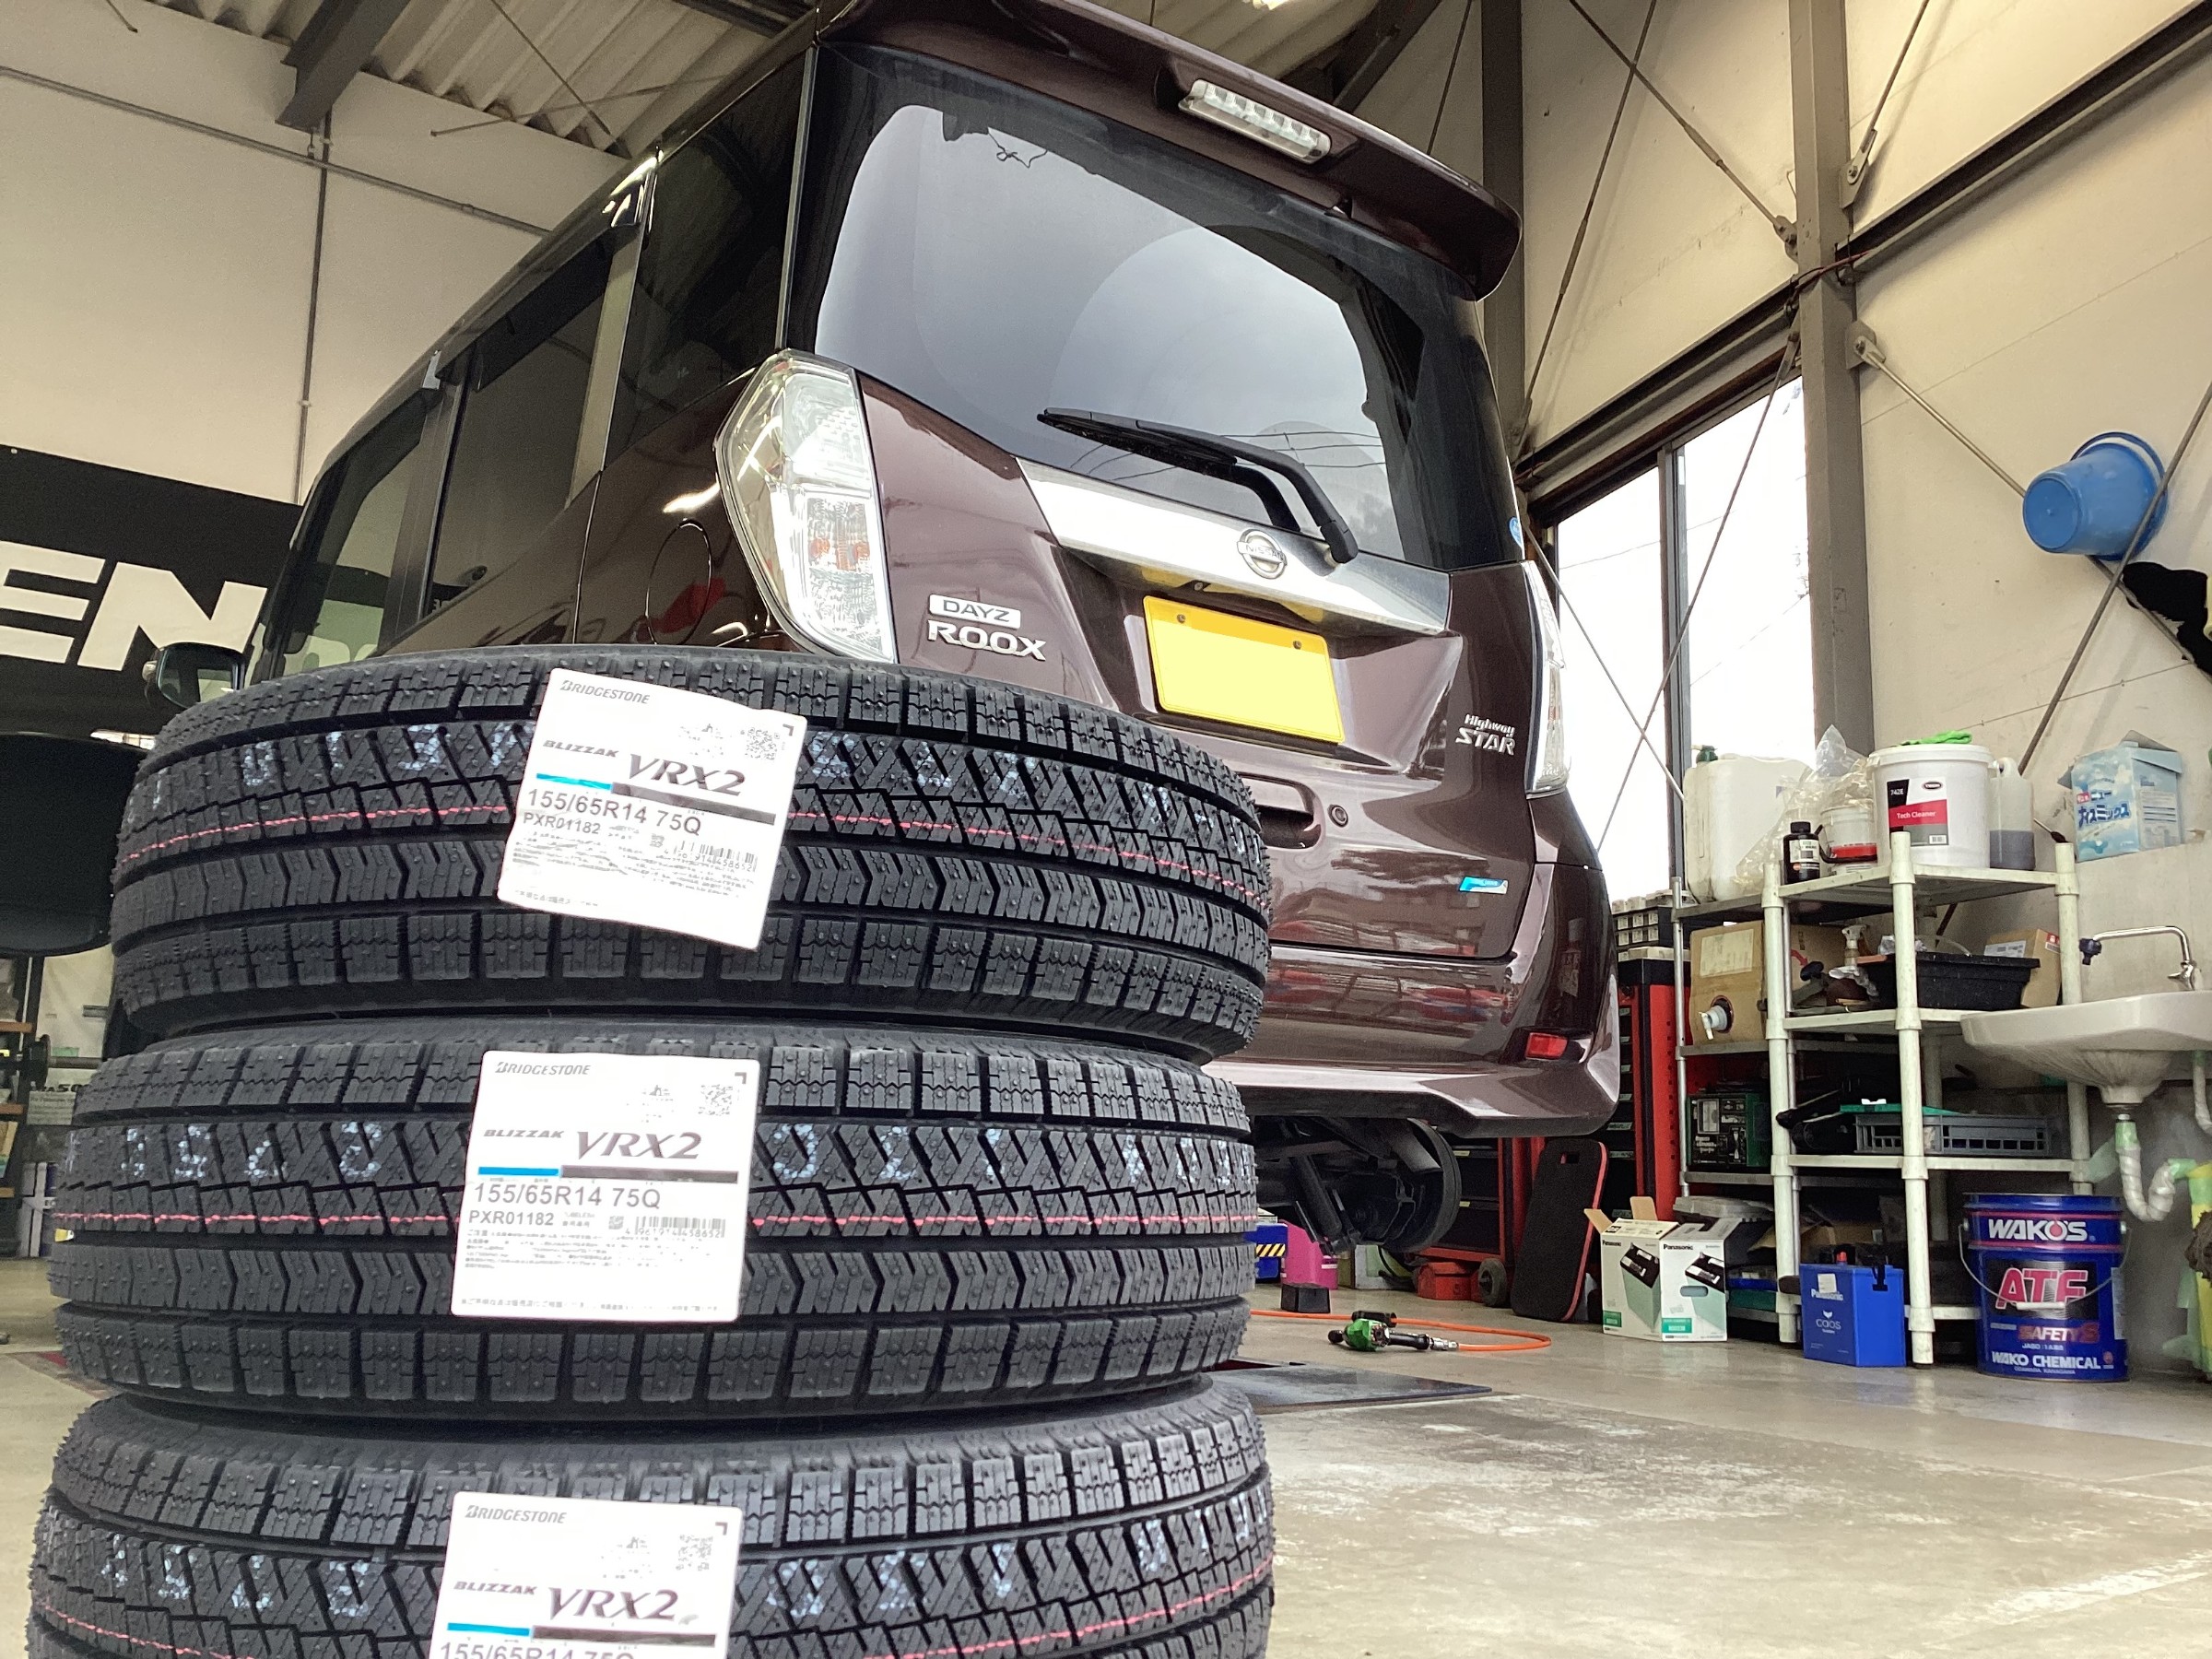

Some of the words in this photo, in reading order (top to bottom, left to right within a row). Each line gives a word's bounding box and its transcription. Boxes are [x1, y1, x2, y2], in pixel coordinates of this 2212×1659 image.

[1245, 544, 1285, 563] NISSAN
[943, 599, 1010, 622] DAYZ
[927, 619, 1047, 662] ROOX
[559, 679, 651, 705] BRIDGESTONE
[1464, 713, 1516, 737] Highway
[543, 739, 620, 759] BLIZZAK
[1454, 726, 1517, 756] STAR
[629, 753, 747, 796] VRX2
[523, 812, 602, 836] PXR01182
[526, 788, 647, 824] 155/65R14
[656, 809, 702, 837] 75Q
[495, 1062, 592, 1076] BRIDGESTONE
[483, 1129, 565, 1139] BLIZZAK
[577, 1131, 702, 1160] VRX2
[473, 1183, 603, 1207] 155/65R14
[611, 1188, 662, 1210] 75Q
[468, 1209, 555, 1227] PXR01182
[1602, 1240, 1622, 1248] Panasonic
[1994, 1266, 2088, 1310] ATF
[1815, 1318, 1841, 1330] caos
[1992, 1351, 2030, 1368] WAKO
[2032, 1355, 2101, 1370] CHEMICAL
[465, 1504, 567, 1524] BRIDGESTONE
[453, 1582, 537, 1595] BLIZZAK
[547, 1587, 678, 1620] VRX2
